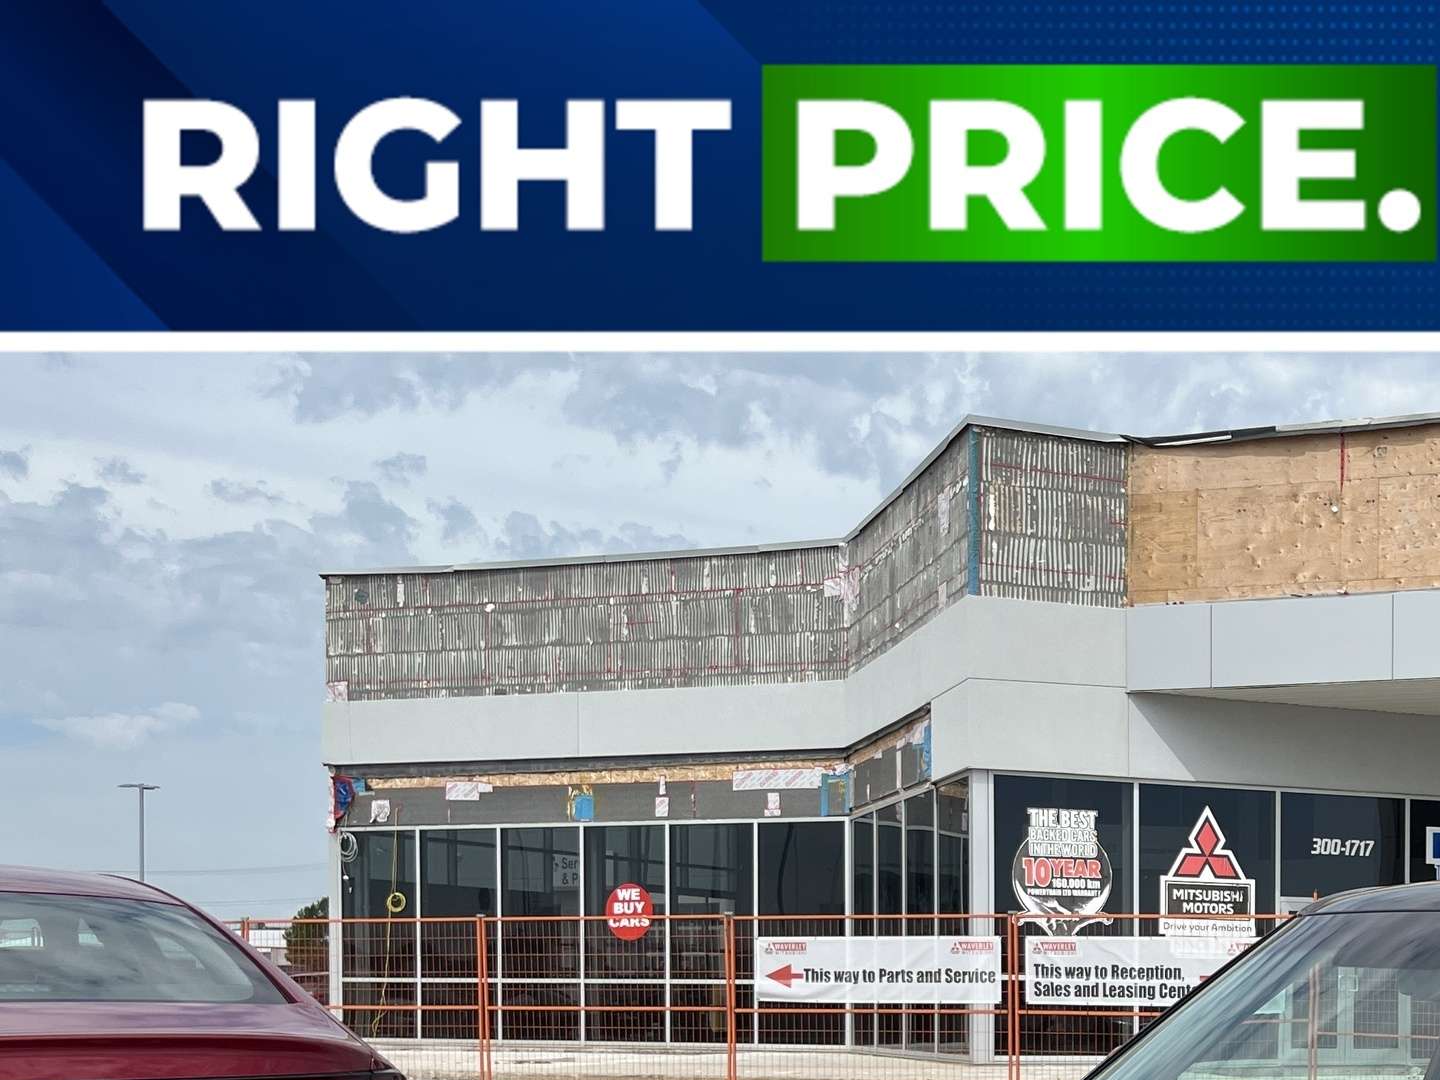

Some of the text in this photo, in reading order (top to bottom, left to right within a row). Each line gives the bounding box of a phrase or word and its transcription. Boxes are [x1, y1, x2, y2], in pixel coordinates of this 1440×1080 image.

[1027, 808, 1098, 829] THE BEST
[1029, 827, 1098, 843] BACKED CARS
[1029, 842, 1098, 858] IN THE WORLD
[1310, 838, 1375, 857] 300-1717
[1023, 858, 1102, 887] 10 YEAR
[616, 888, 641, 901] WE
[1173, 889, 1243, 903] MITSUBISHI
[613, 901, 645, 915] BUY
[1182, 902, 1235, 914] MOTORS
[608, 916, 650, 928] CARS
[1163, 922, 1252, 934] Drive your Ambition
[804, 968, 996, 985] This way to Parts and Service
[1034, 963, 1185, 982] This way to Reception,
[1034, 982, 1071, 997] Sales
[1074, 982, 1099, 998] and
[1103, 982, 1156, 1000] Leasing
